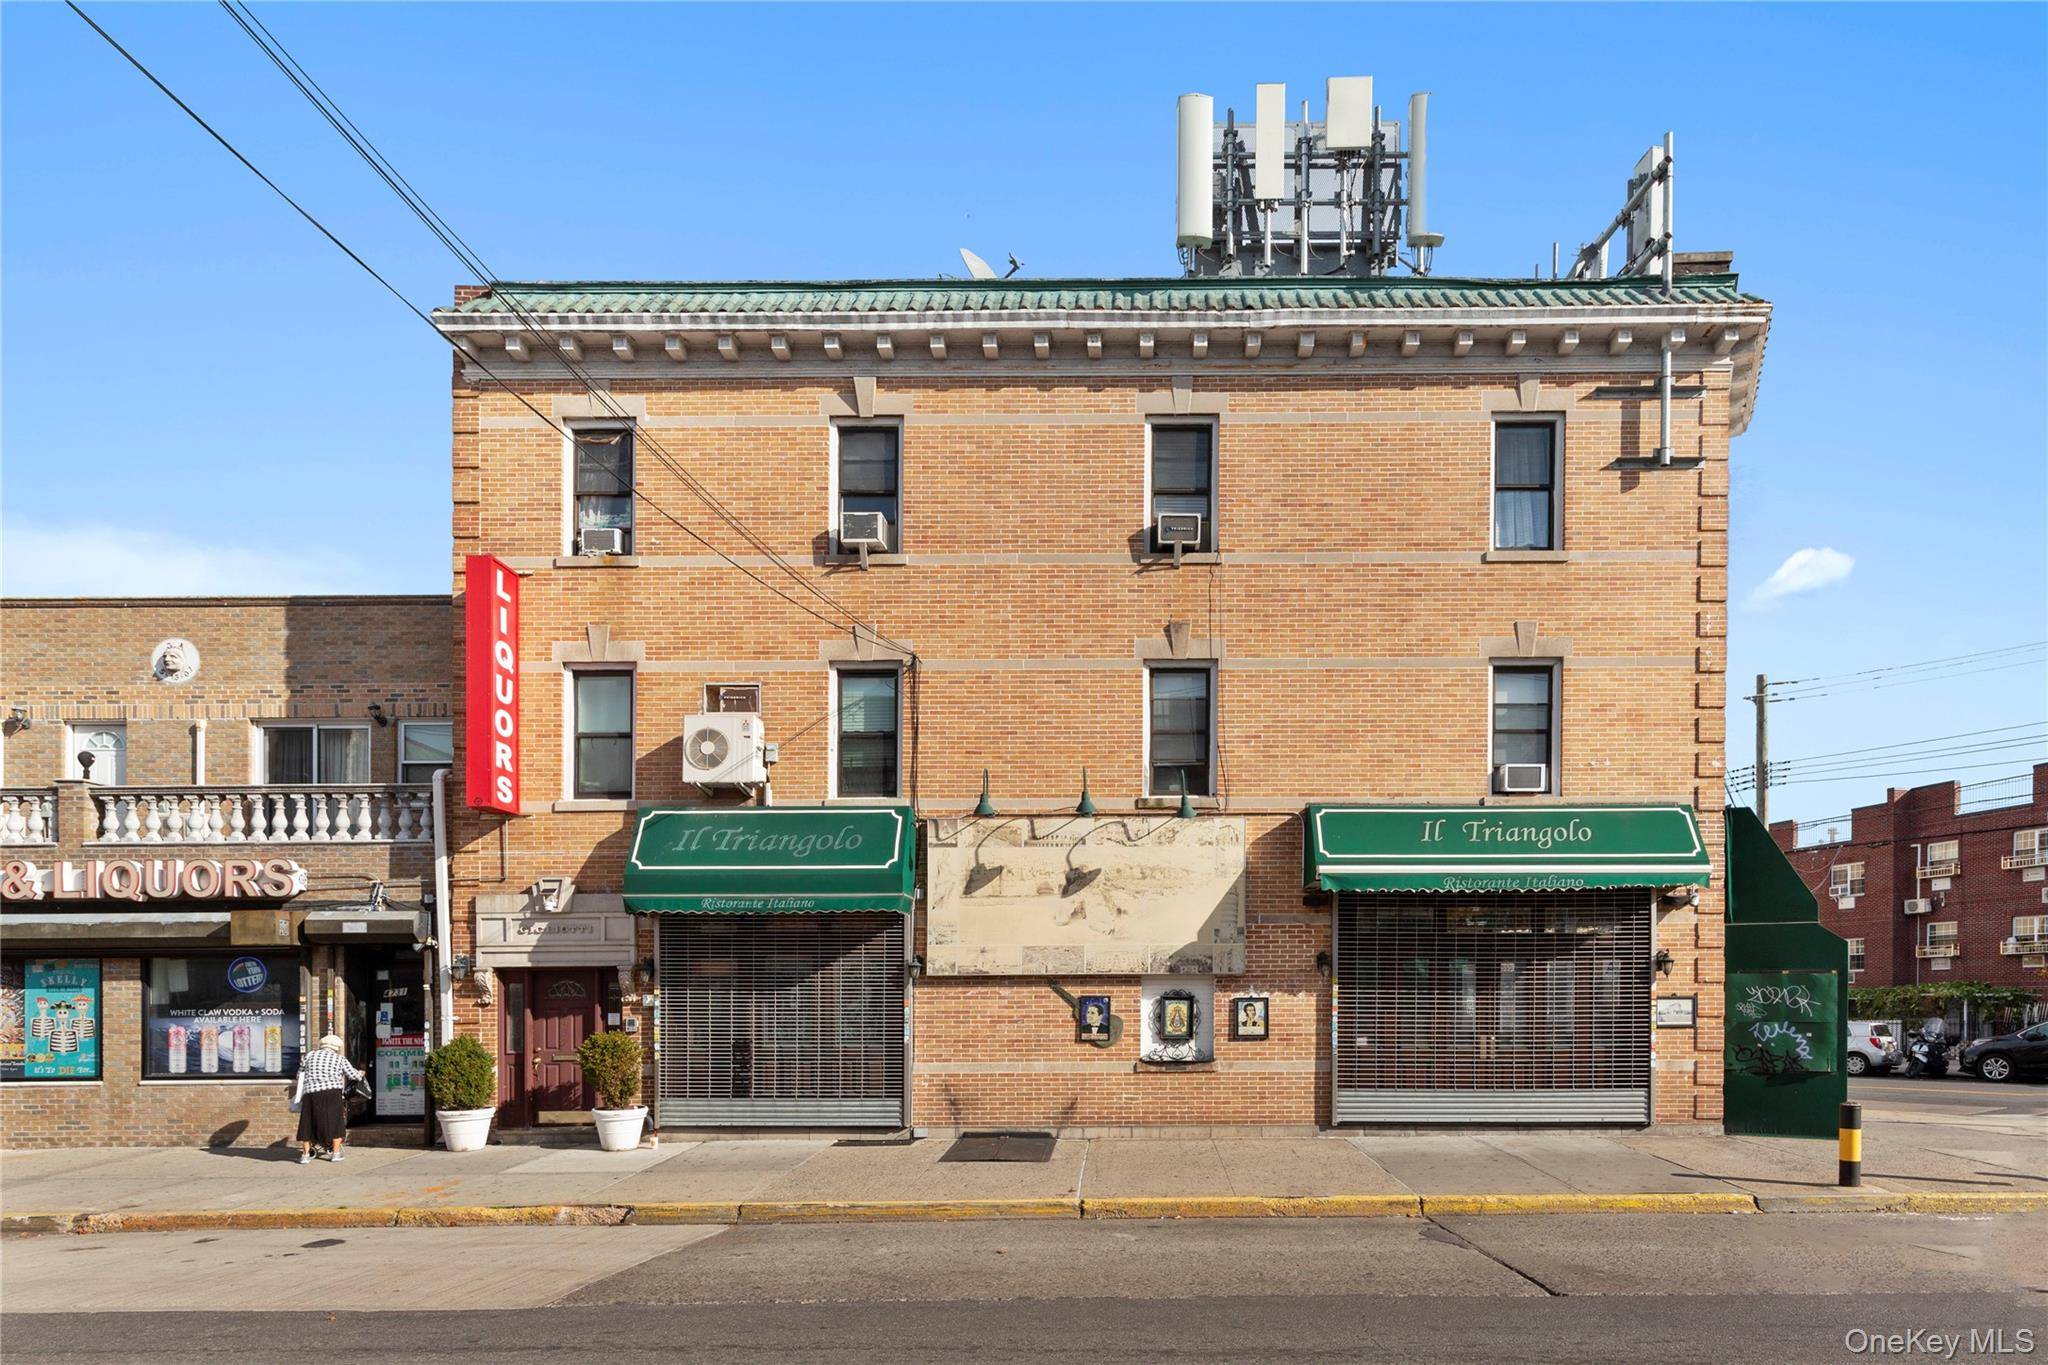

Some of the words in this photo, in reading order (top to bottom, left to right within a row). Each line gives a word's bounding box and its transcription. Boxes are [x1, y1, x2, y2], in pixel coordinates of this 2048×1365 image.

[494, 569, 515, 804] LIQUORS
[671, 826, 712, 851] Il
[712, 825, 864, 857] Triangolo
[1420, 820, 1446, 843] Il
[1462, 819, 1593, 849] Triangolo
[0, 859, 37, 900] &
[53, 859, 297, 901] LIQUORS
[1443, 875, 1521, 889] Ristorante
[1524, 875, 1585, 889] Italiano
[700, 897, 764, 910] Ristorante
[766, 897, 815, 909] Italiano
[169, 1009, 196, 1017] WHITE
[261, 1008, 286, 1016] SODA
[194, 1016, 238, 1024] AVAILABLE
